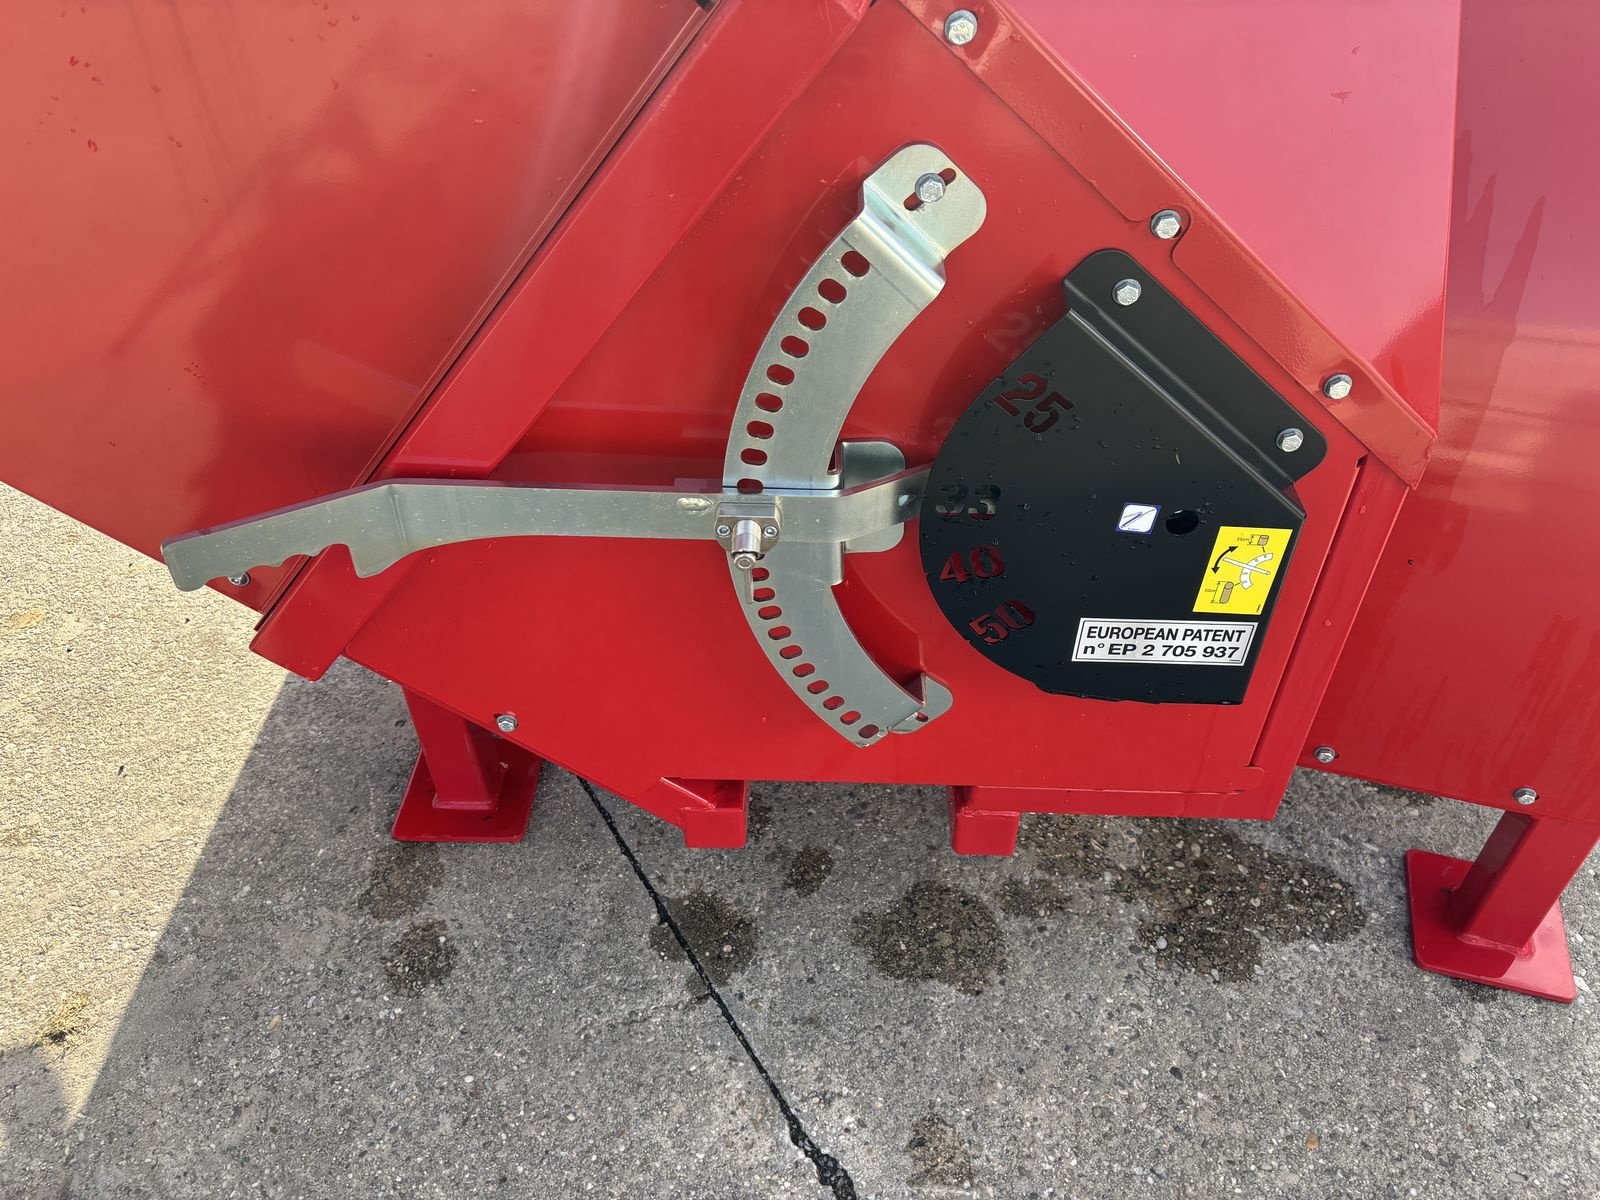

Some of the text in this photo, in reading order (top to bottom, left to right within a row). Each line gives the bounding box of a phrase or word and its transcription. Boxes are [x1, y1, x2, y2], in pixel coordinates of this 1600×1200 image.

[993, 372, 1074, 433] 25
[935, 484, 1001, 520] 33
[940, 545, 1005, 583] 40
[968, 600, 1035, 643] 50
[1086, 626, 1246, 642] EUROPEAN PATENT
[1108, 643, 1137, 656] EP
[1142, 645, 1155, 656] 2
[1161, 645, 1197, 658] 705
[1202, 646, 1240, 659] 937
